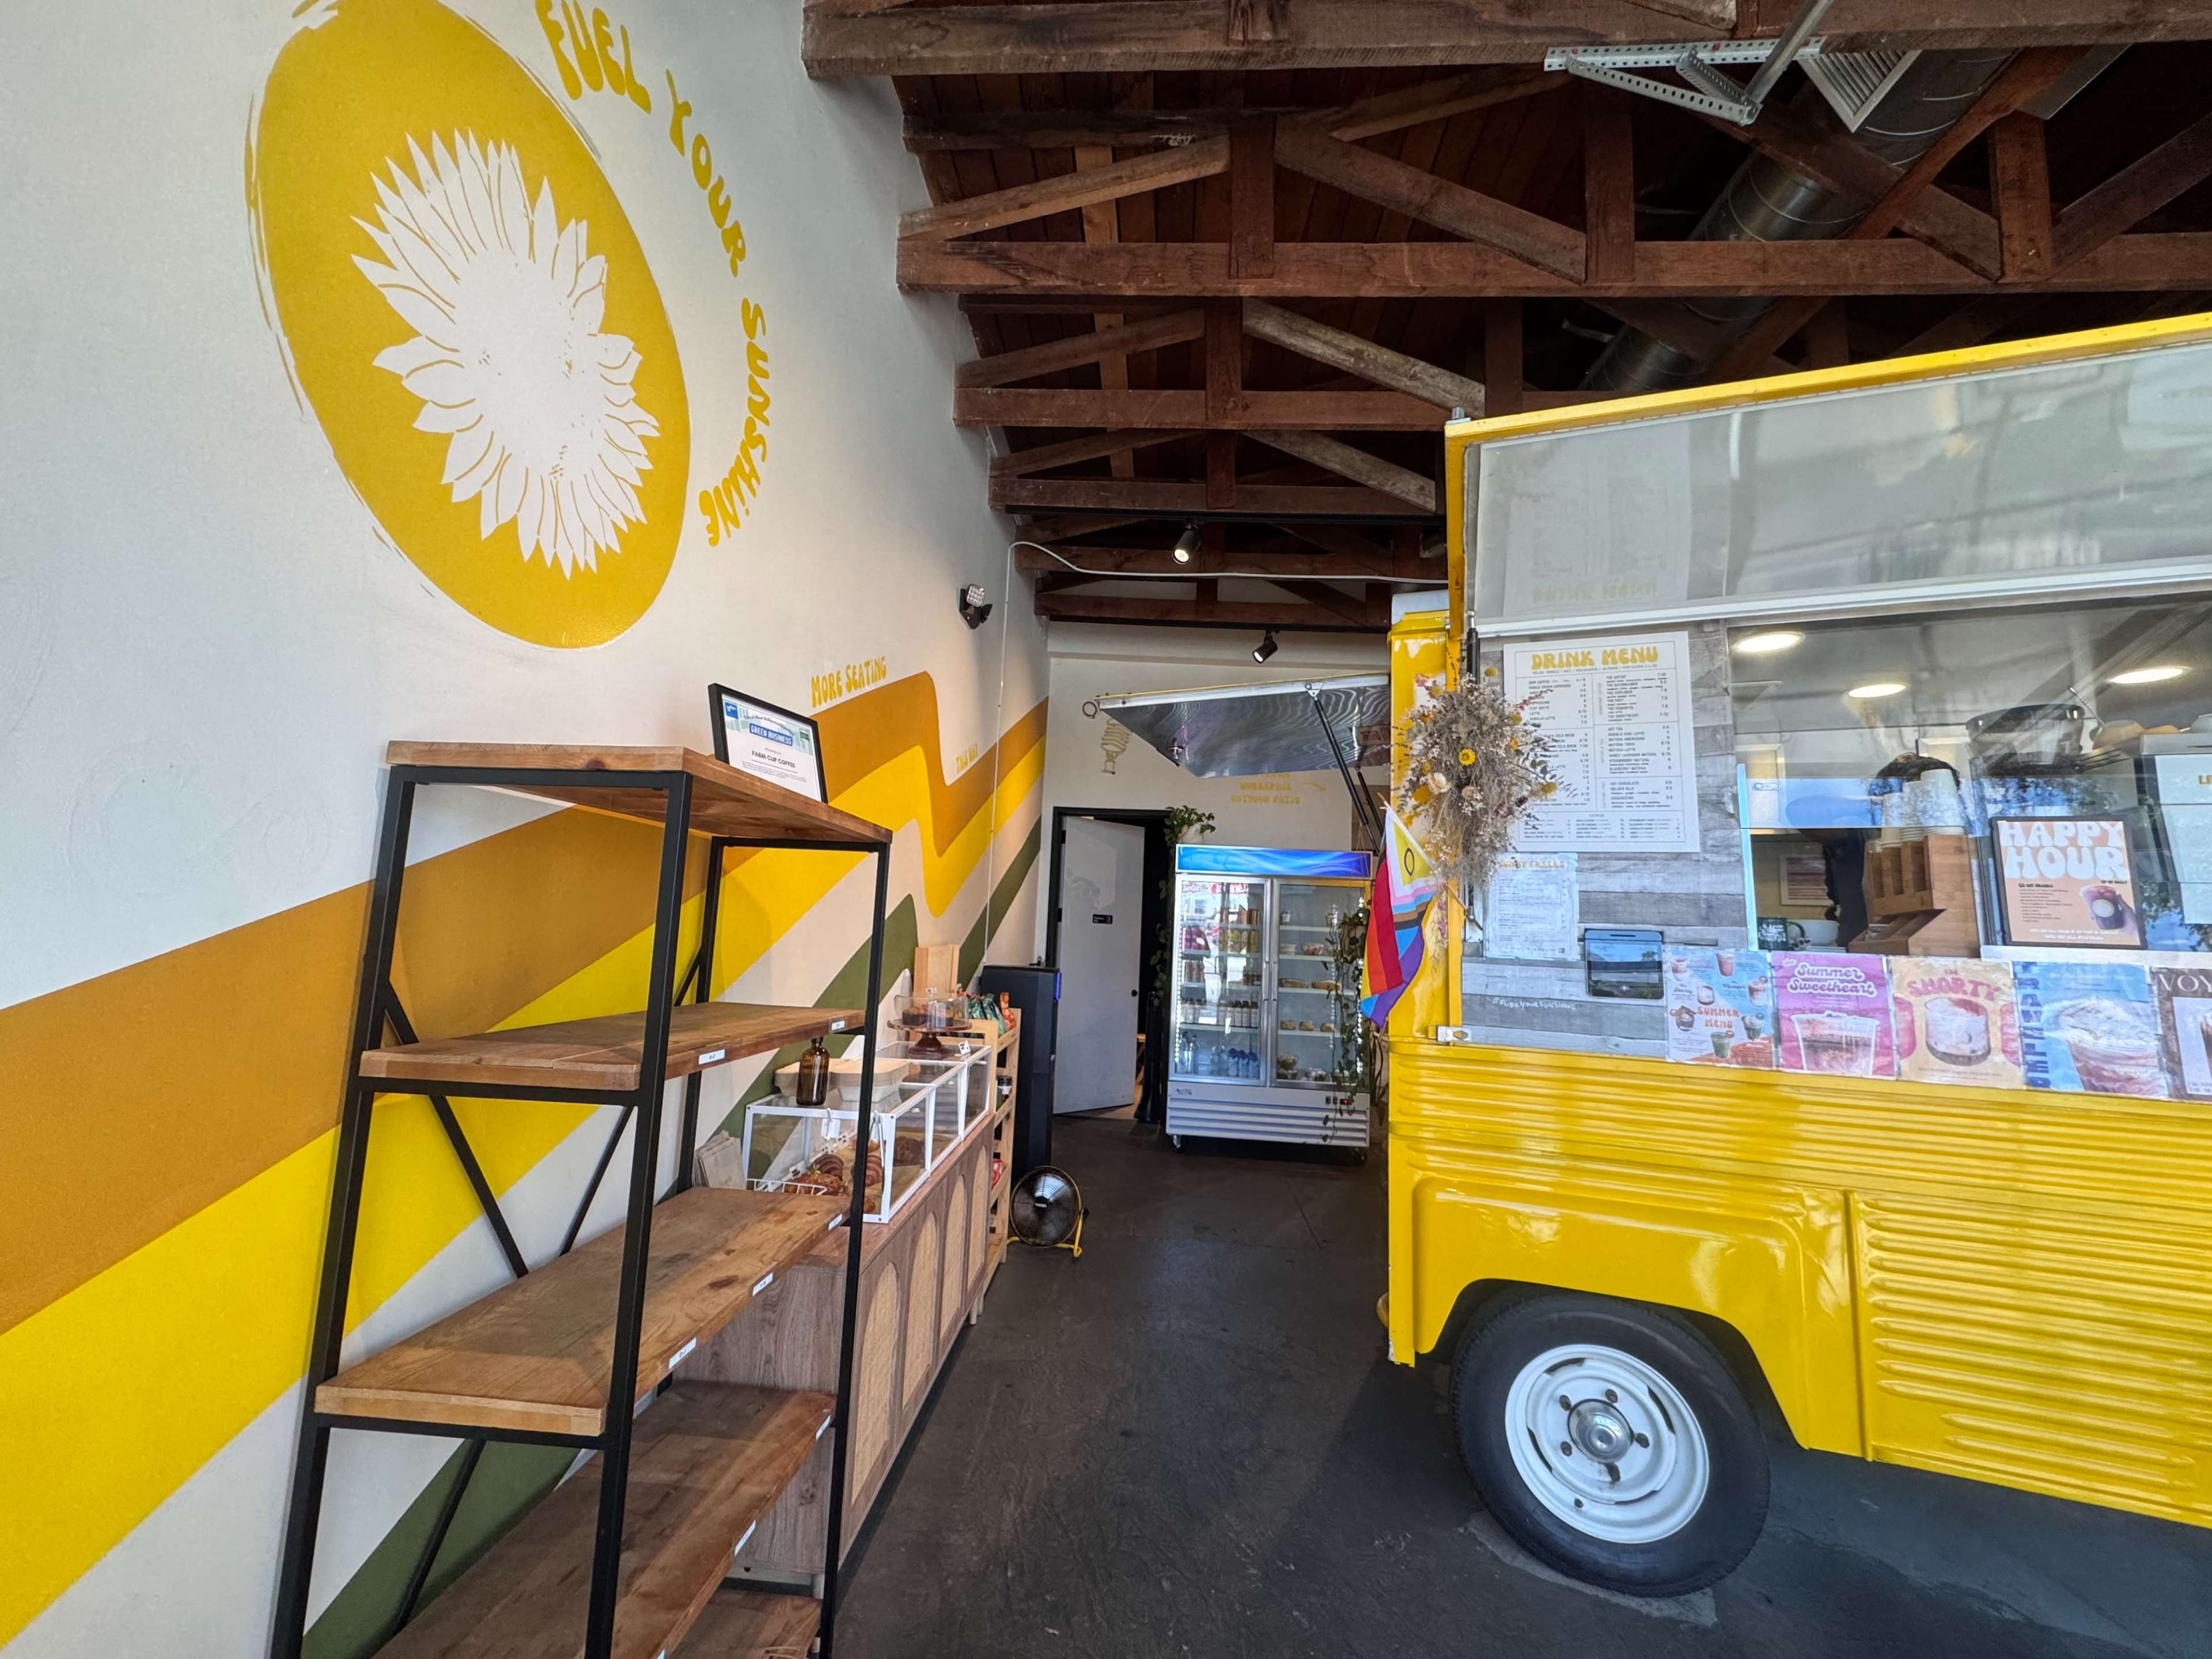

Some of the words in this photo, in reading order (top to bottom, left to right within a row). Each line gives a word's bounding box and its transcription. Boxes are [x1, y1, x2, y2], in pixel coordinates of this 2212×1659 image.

[535, 0, 652, 114] FUEL
[666, 70, 746, 278] YOUR
[699, 297, 770, 547] SUNSHINE
[1532, 650, 1595, 670] DRINK
[1601, 646, 1658, 666] MENU
[810, 669, 842, 708] MORE
[845, 656, 887, 694] SEATING
[750, 725, 767, 738] GREEN
[767, 731, 793, 745] BUSINESS
[752, 750, 767, 759] FARM
[778, 759, 796, 768] COFFEE
[1272, 796, 1301, 805] PATIO
[1999, 821, 2124, 847] HAPPY
[2005, 846, 2131, 880] HOUR
[1797, 963, 1863, 980] Summer
[1789, 979, 1876, 995] Sweetheart
[1907, 977, 2001, 1001] SHORTY
[1698, 1006, 1740, 1018] SUMMER
[1705, 1018, 1733, 1029] MENU
